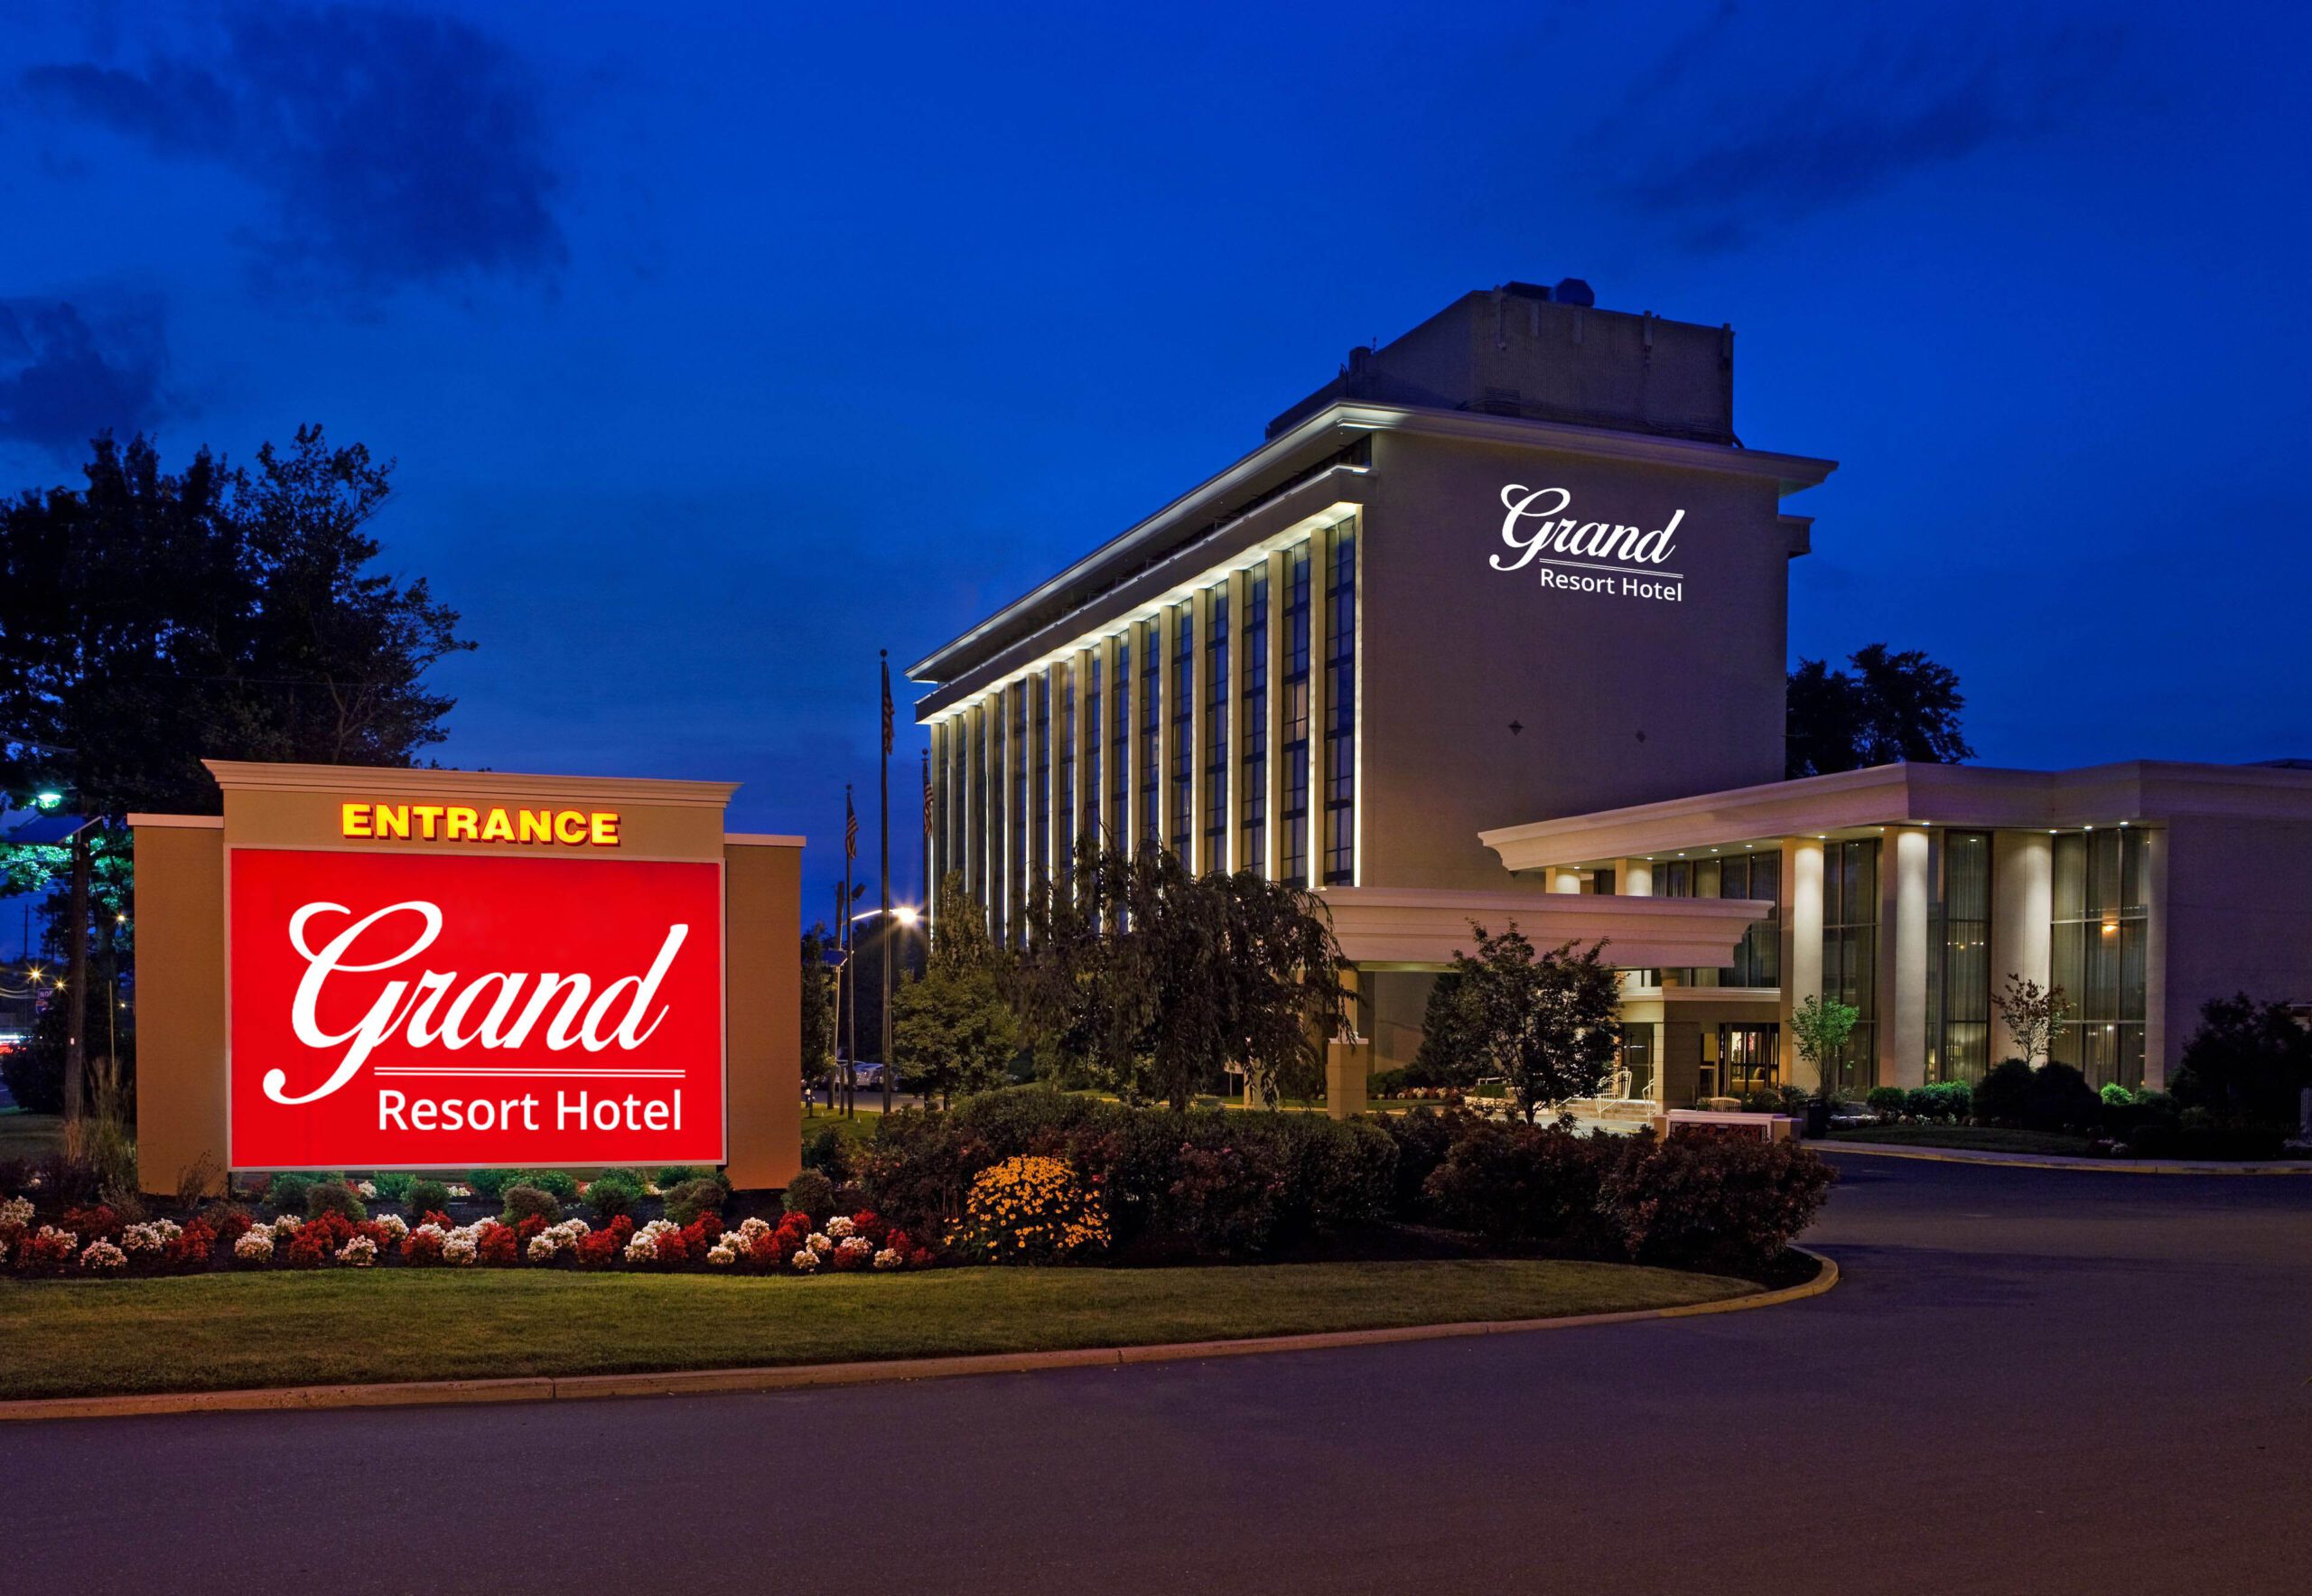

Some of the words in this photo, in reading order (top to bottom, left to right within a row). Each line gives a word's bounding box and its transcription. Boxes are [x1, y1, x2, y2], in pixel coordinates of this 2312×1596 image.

[1489, 483, 1685, 572] Grand
[1541, 568, 1616, 594] Resort
[1623, 577, 1683, 602] Hotel
[341, 803, 620, 845] ENTRANCE
[263, 901, 689, 1105] Grand
[378, 1089, 539, 1131] Resort
[557, 1089, 681, 1131] Hotel
